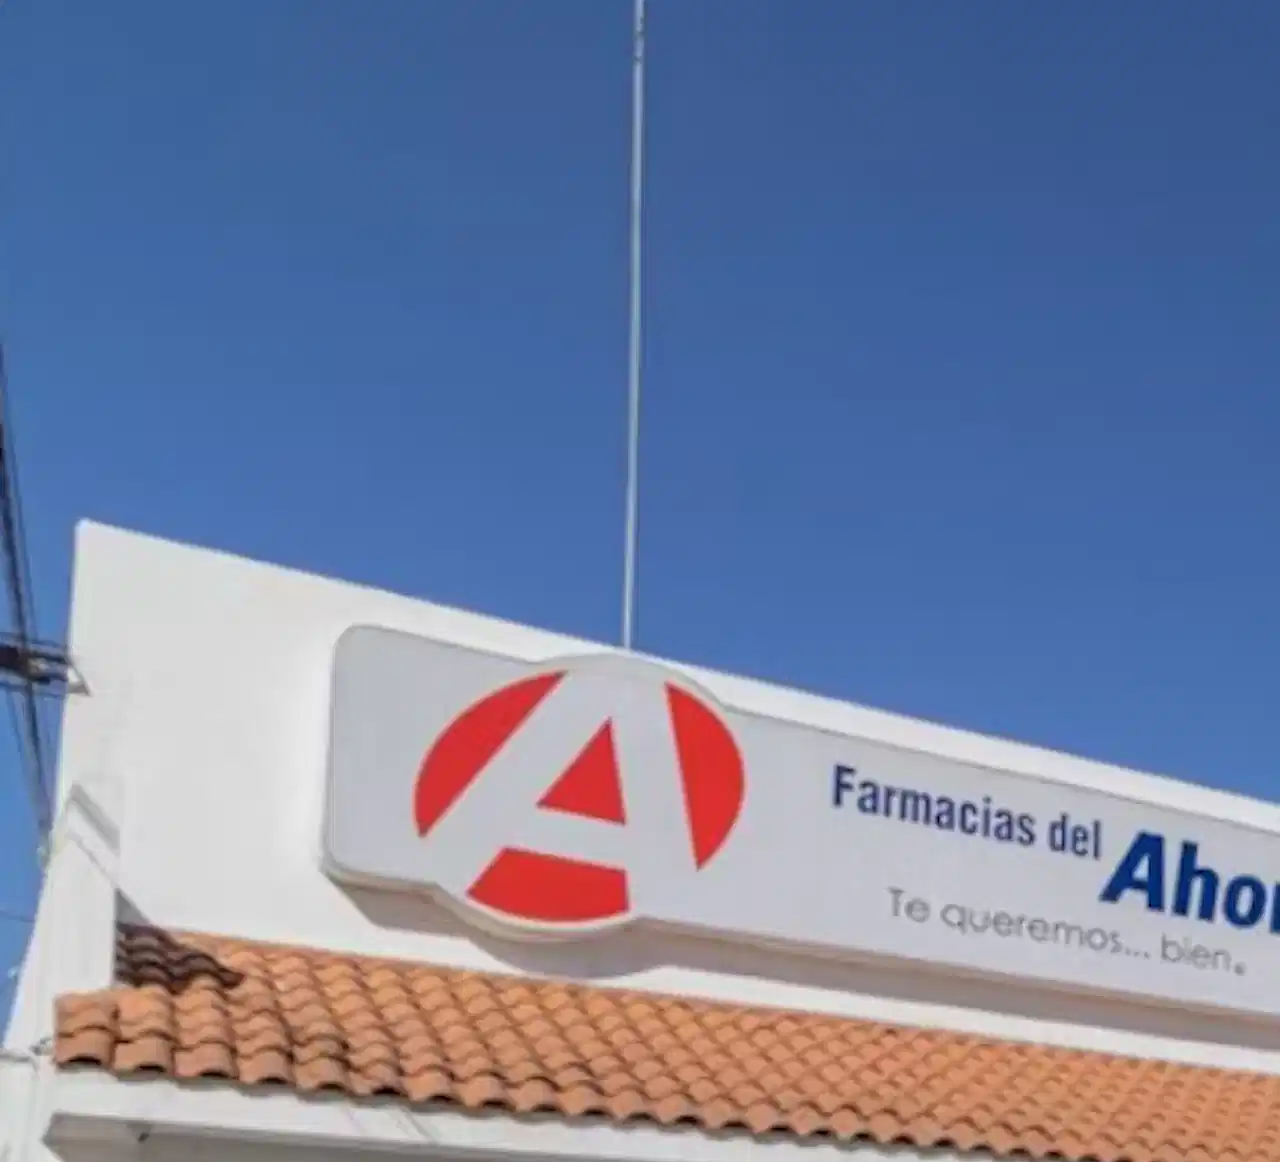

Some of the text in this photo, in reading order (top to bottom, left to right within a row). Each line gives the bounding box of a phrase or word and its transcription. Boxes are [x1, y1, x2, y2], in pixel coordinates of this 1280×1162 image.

[833, 764, 1101, 860] Farmacias del
[888, 886, 931, 922] Te
[939, 903, 1151, 957] queremos...
